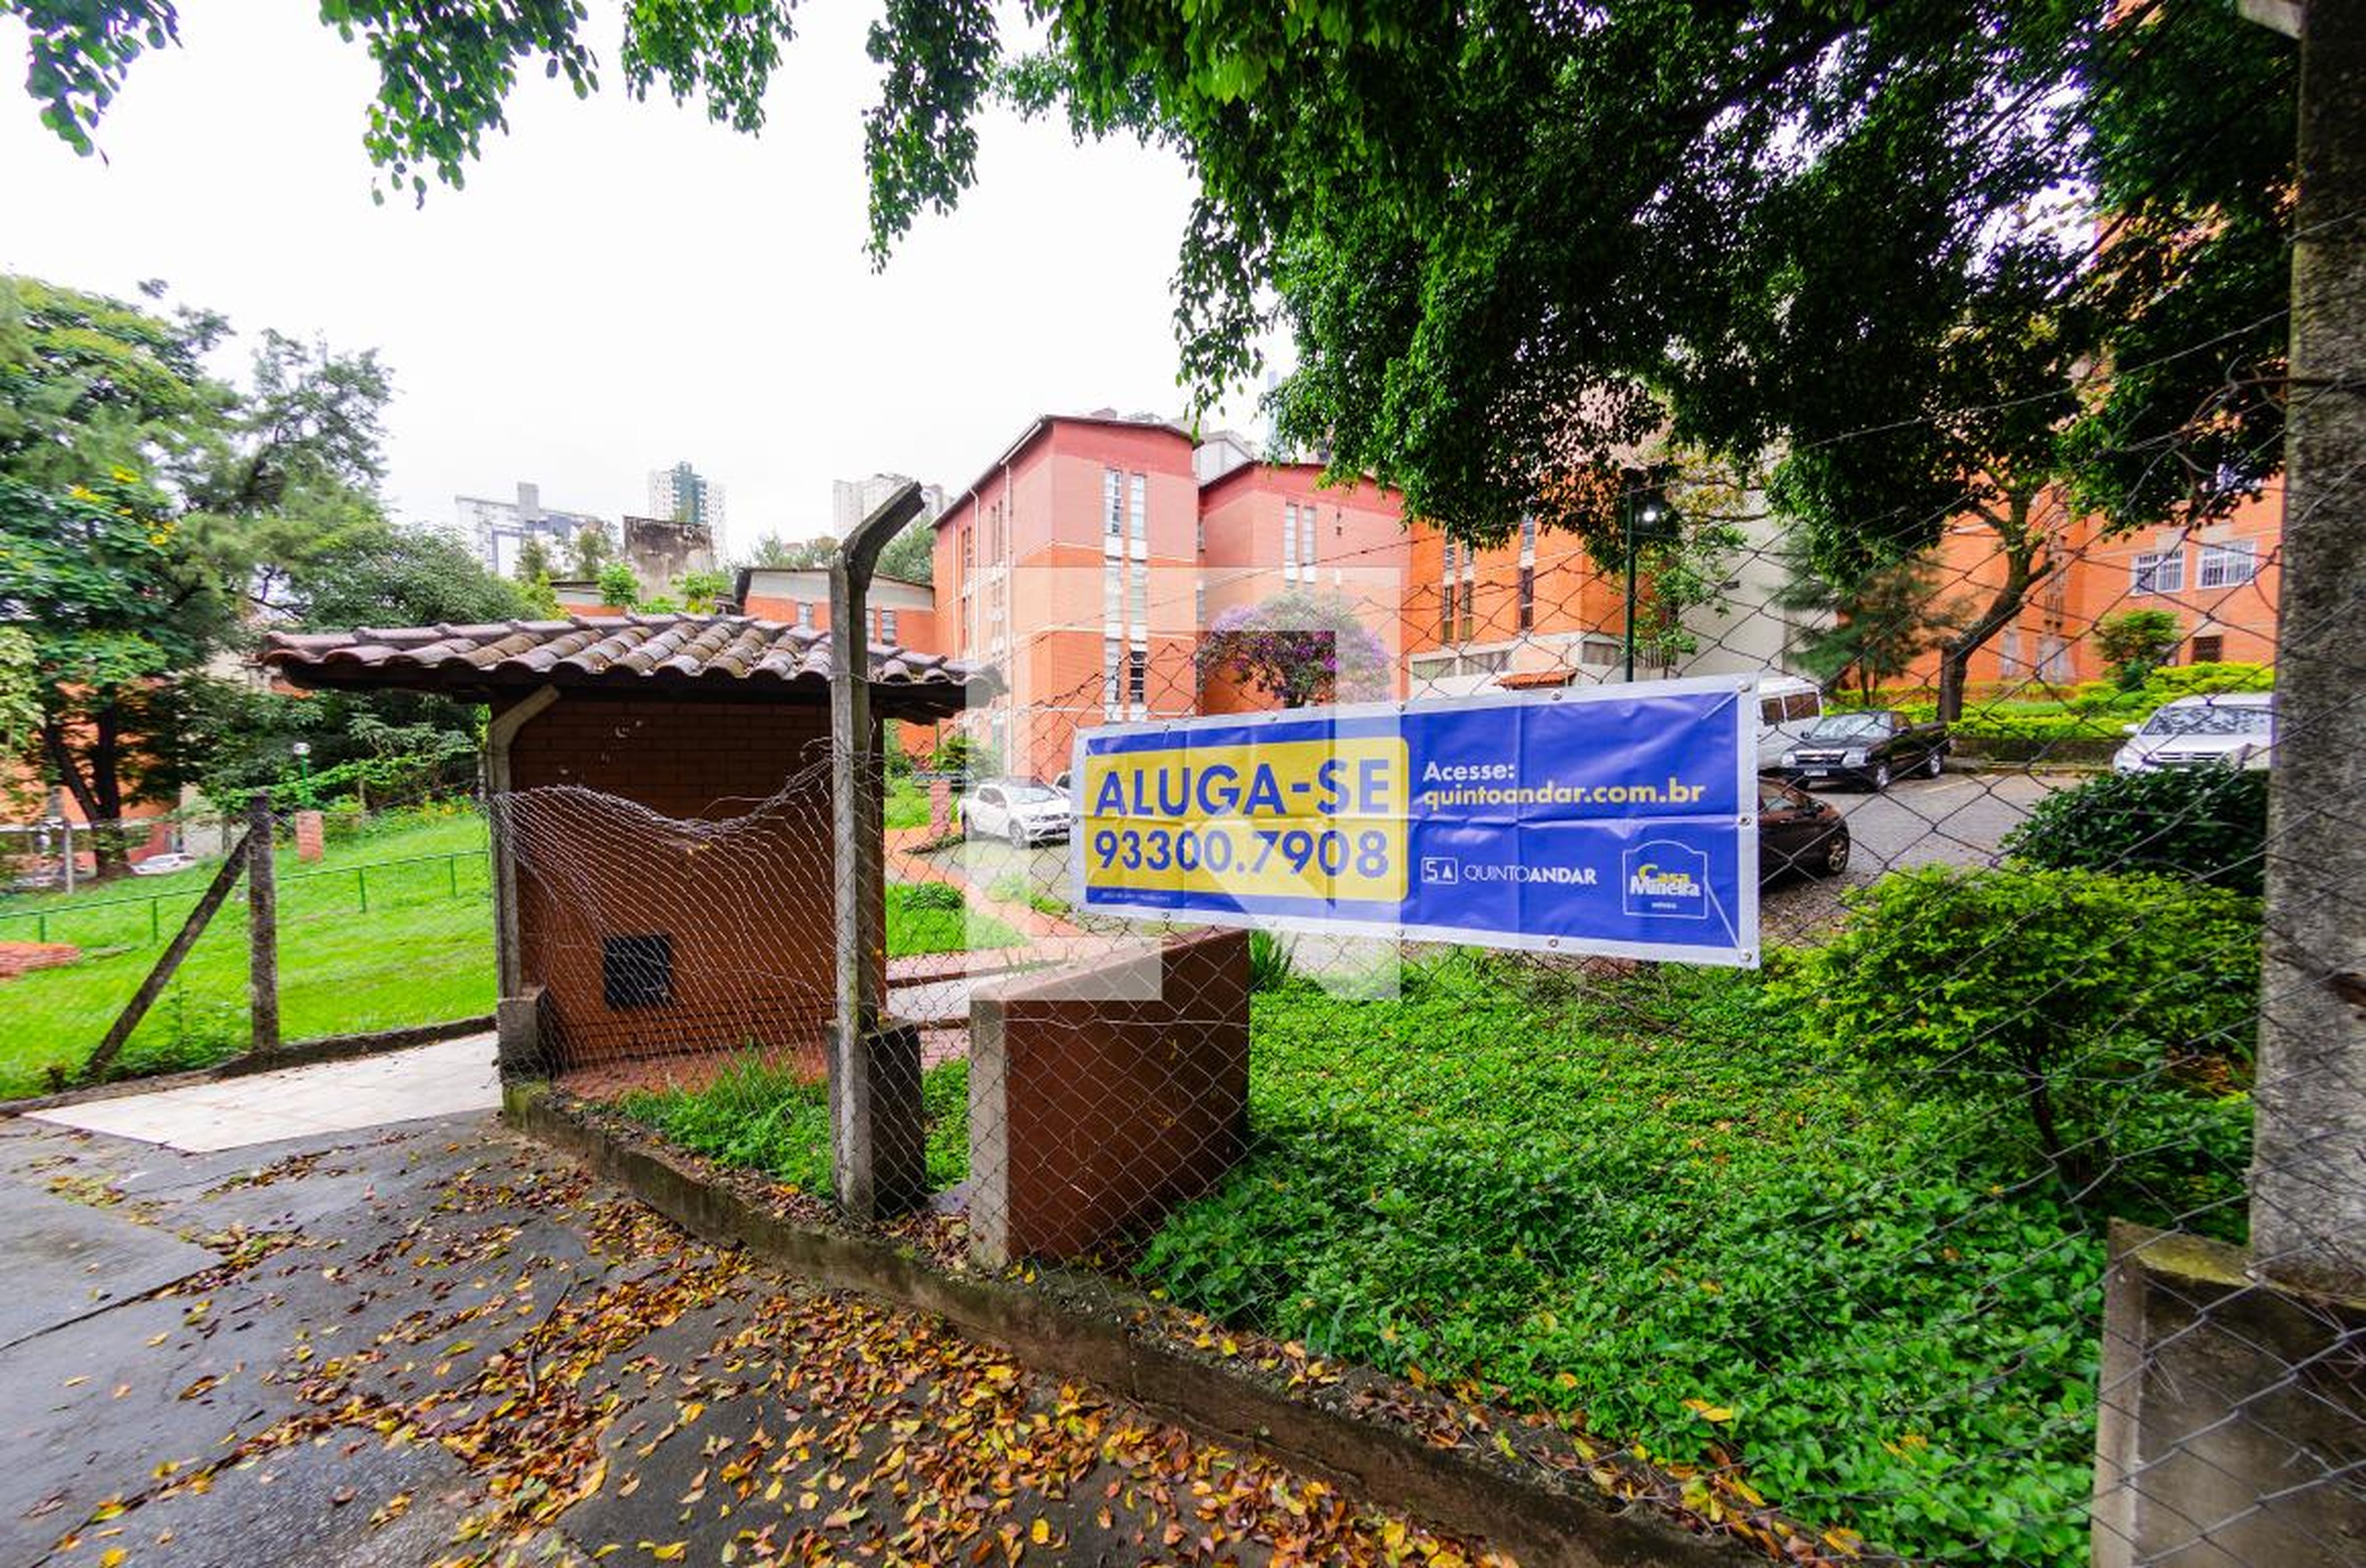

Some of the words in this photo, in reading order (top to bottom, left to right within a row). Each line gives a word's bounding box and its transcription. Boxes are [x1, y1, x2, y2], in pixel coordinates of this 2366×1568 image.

[1423, 762, 1516, 781] Acesse:
[1094, 758, 1389, 818] ALUGA-SE
[1423, 779, 1705, 810] quintoandar.com.br
[1094, 829, 1389, 879] 93300.7908
[1464, 865, 1598, 885] QUINTOANDAR
